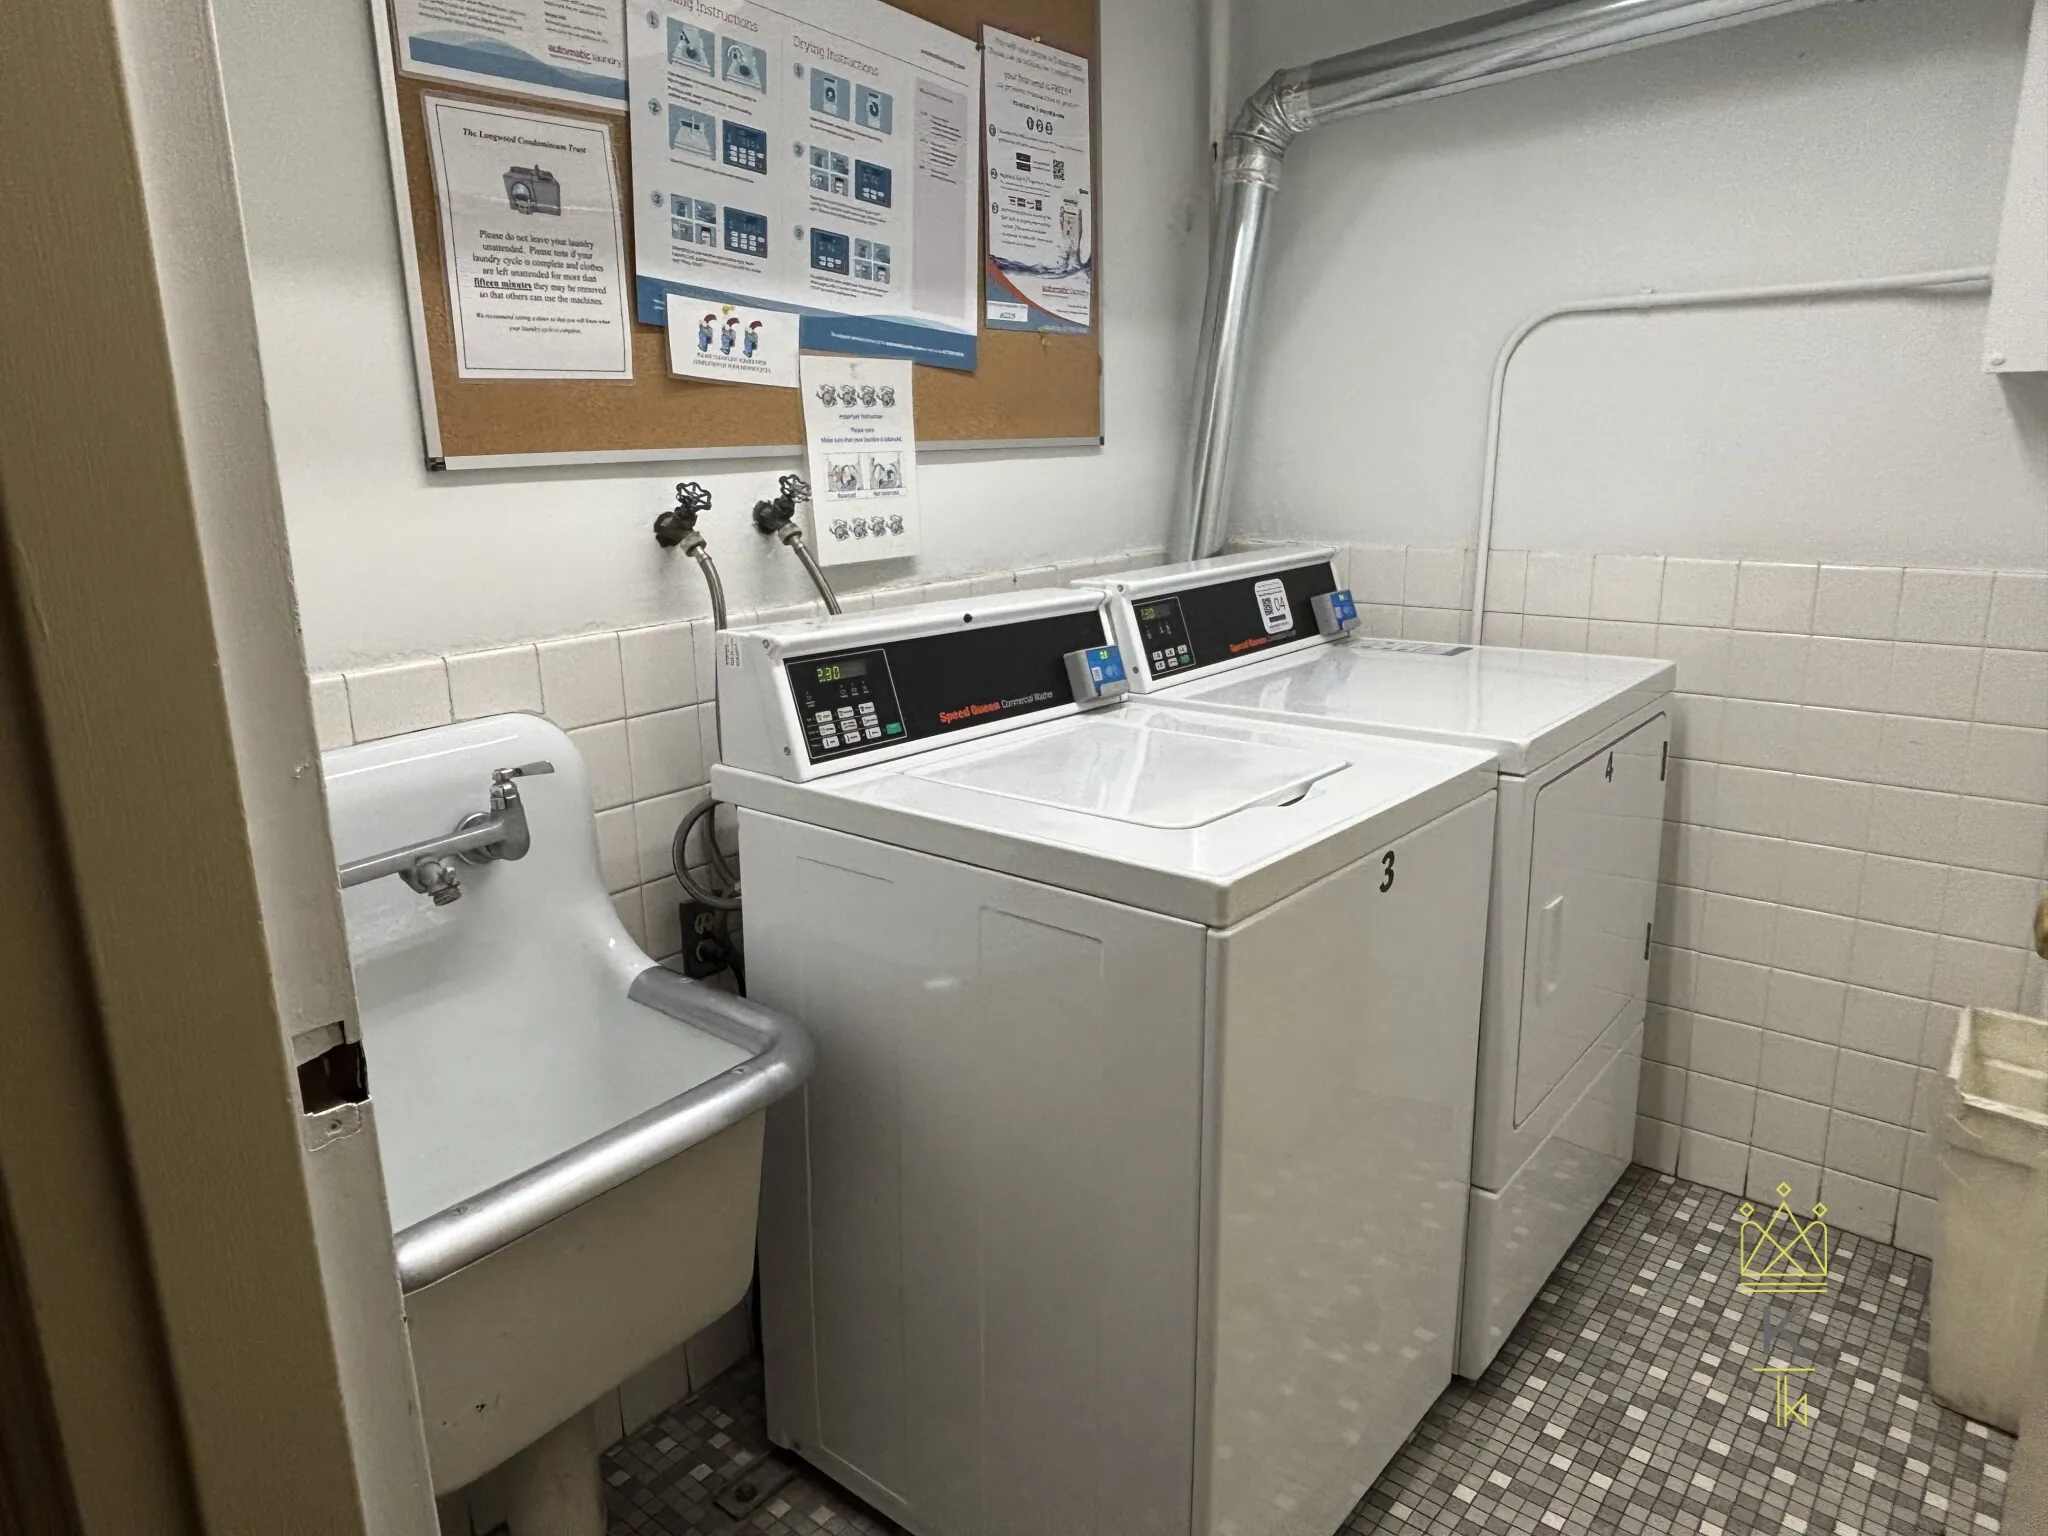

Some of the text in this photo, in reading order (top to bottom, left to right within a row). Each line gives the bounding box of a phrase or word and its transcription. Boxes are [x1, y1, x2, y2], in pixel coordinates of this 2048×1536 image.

[793, 35, 825, 60] Drying
[462, 128, 477, 137] The
[479, 130, 516, 143] Longwood
[568, 144, 587, 154] Trust
[480, 229, 503, 239] Please
[505, 232, 514, 240] do
[530, 234, 549, 244] leave
[551, 238, 566, 247] your
[568, 238, 594, 250] laundry
[472, 253, 500, 265] laundry
[503, 256, 522, 266] cycle
[532, 259, 564, 269] complete
[566, 261, 578, 270] and
[580, 262, 604, 272] clothes
[529, 246, 551, 256] Please
[577, 252, 592, 260] your
[482, 267, 494, 275] are
[496, 266, 508, 276] left
[551, 271, 562, 280] for
[582, 274, 597, 282] than
[474, 277, 499, 288] fifteen
[501, 280, 532, 290] minutes
[533, 281, 549, 292] they
[550, 285, 565, 294] may
[567, 284, 576, 292] be
[489, 290, 504, 299] that
[505, 291, 528, 300] others
[557, 295, 569, 303] the
[939, 706, 970, 724] Speed
[971, 701, 1000, 716] Queen
[1605, 751, 1614, 783] 4
[1380, 850, 1395, 893] 3
